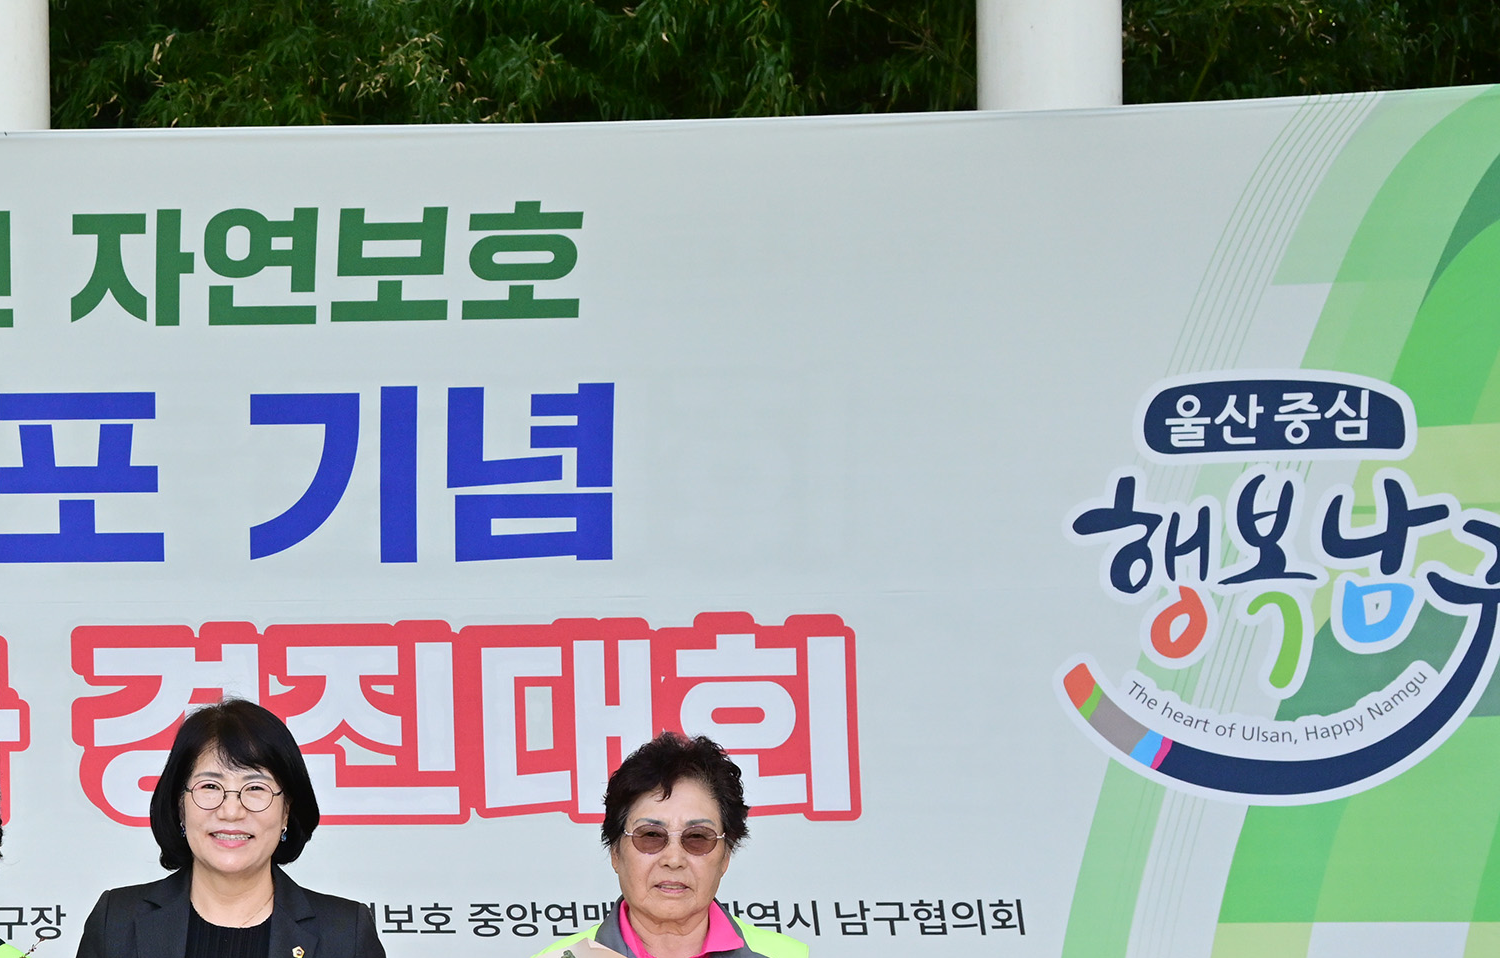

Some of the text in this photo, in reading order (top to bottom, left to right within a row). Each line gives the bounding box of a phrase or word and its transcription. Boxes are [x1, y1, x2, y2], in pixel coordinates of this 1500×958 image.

[69, 201, 585, 329] 자연보호
[1164, 389, 1370, 448] 울산 중심
[249, 382, 615, 563] 기념
[71, 612, 861, 828] 경진대회
[1128, 670, 1429, 746] The heart of Ulsan, Happy Namgu
[834, 898, 1027, 937] 남구협의회
